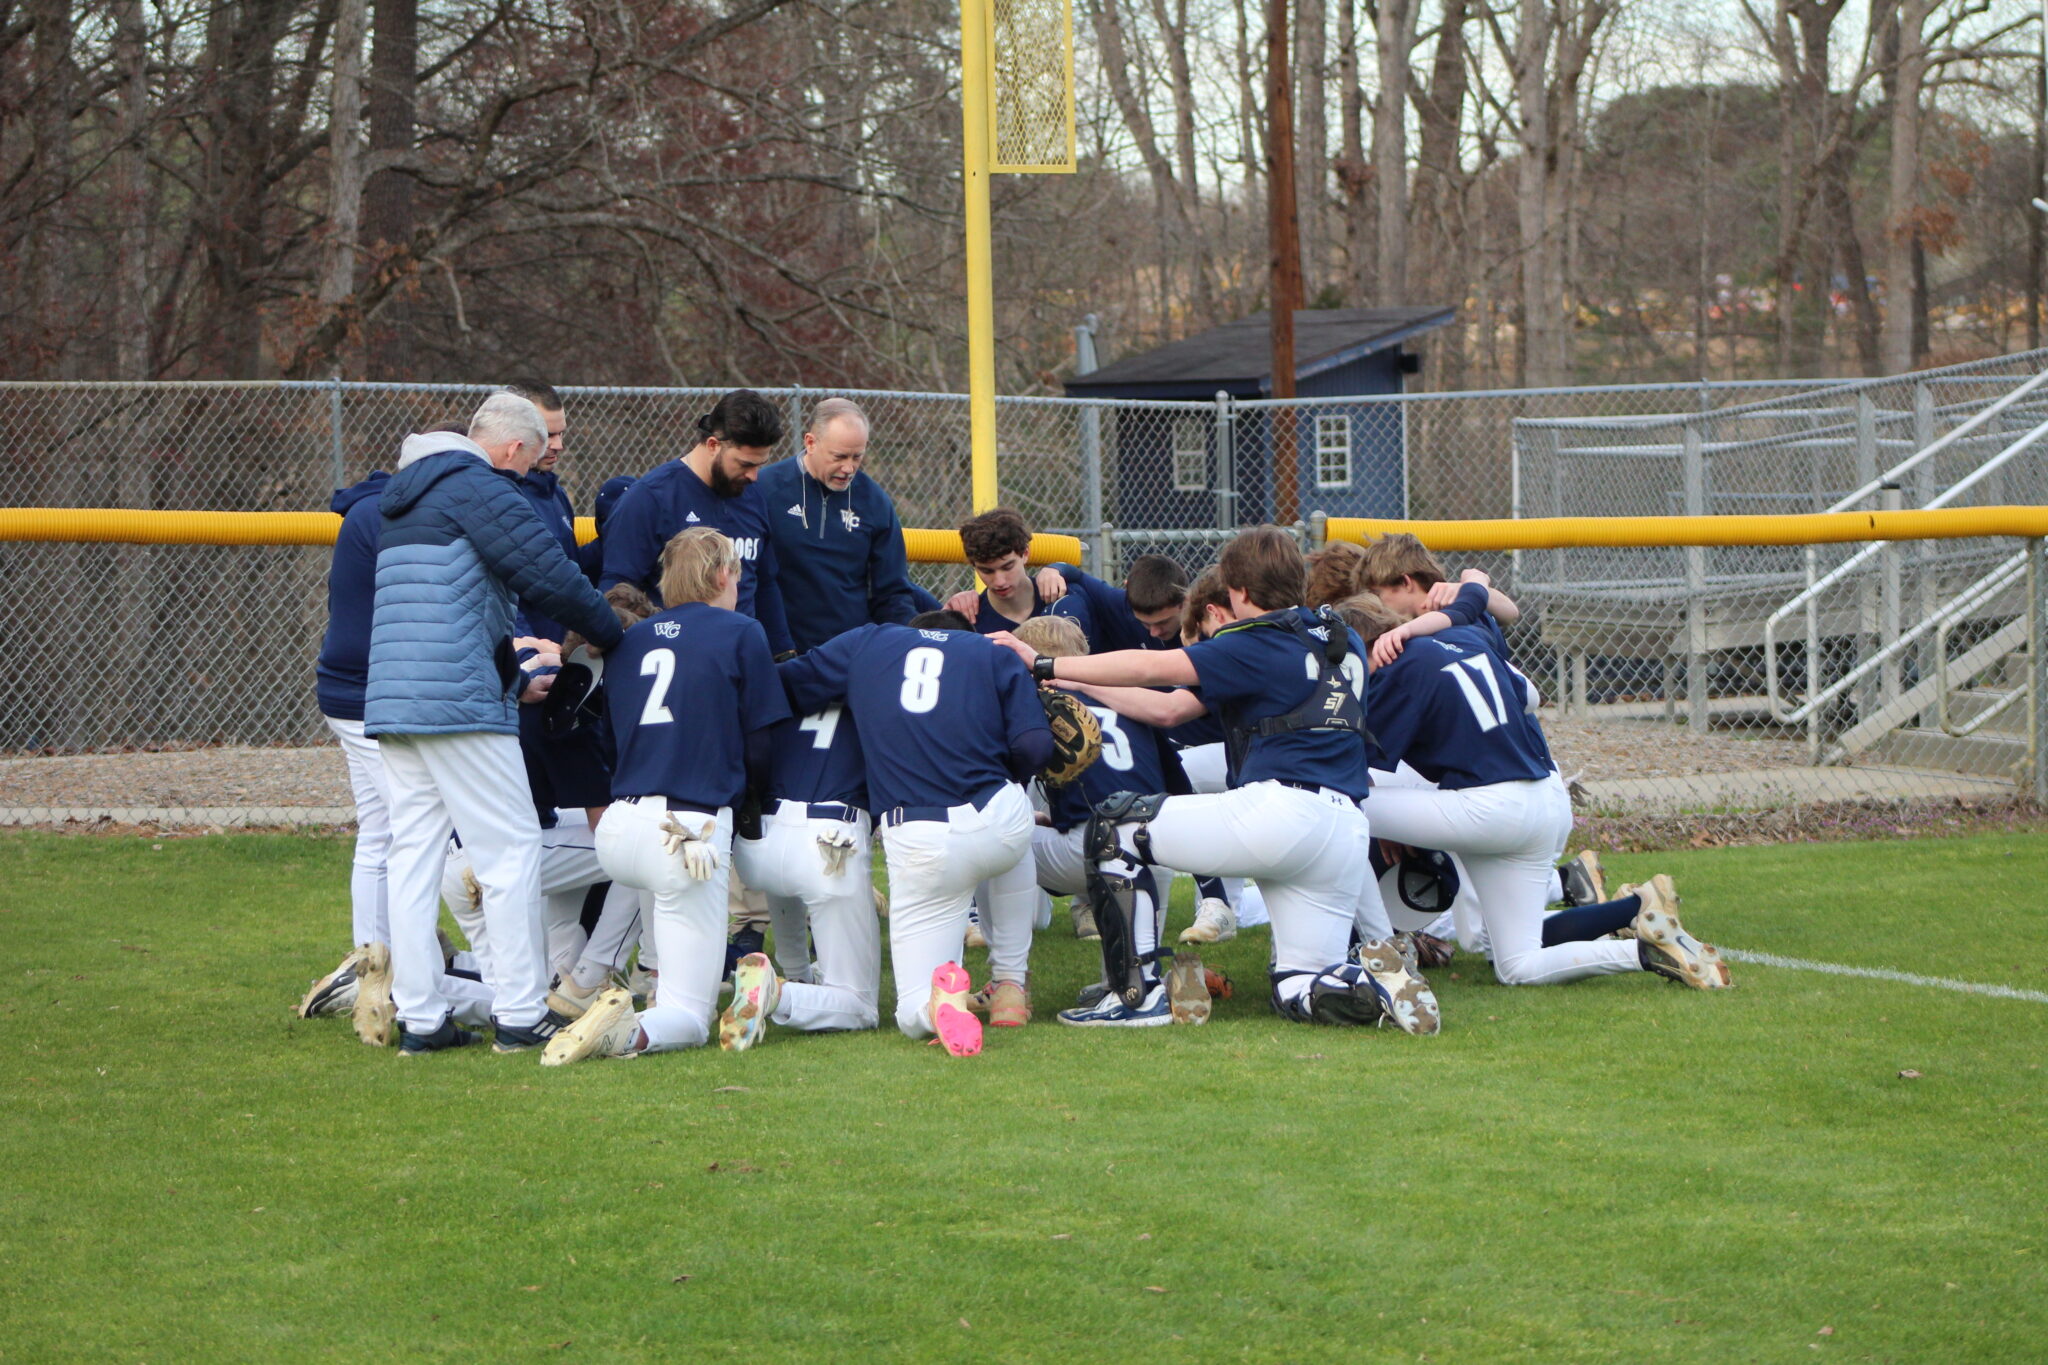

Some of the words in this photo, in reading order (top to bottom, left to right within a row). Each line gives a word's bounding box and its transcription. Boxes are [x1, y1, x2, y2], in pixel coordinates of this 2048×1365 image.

[654, 620, 681, 639] WC
[918, 628, 949, 642] WC
[639, 647, 676, 725] 2
[901, 646, 945, 714] 8
[1440, 652, 1508, 733] 17
[798, 701, 842, 749] 4
[1086, 705, 1134, 771] 3
